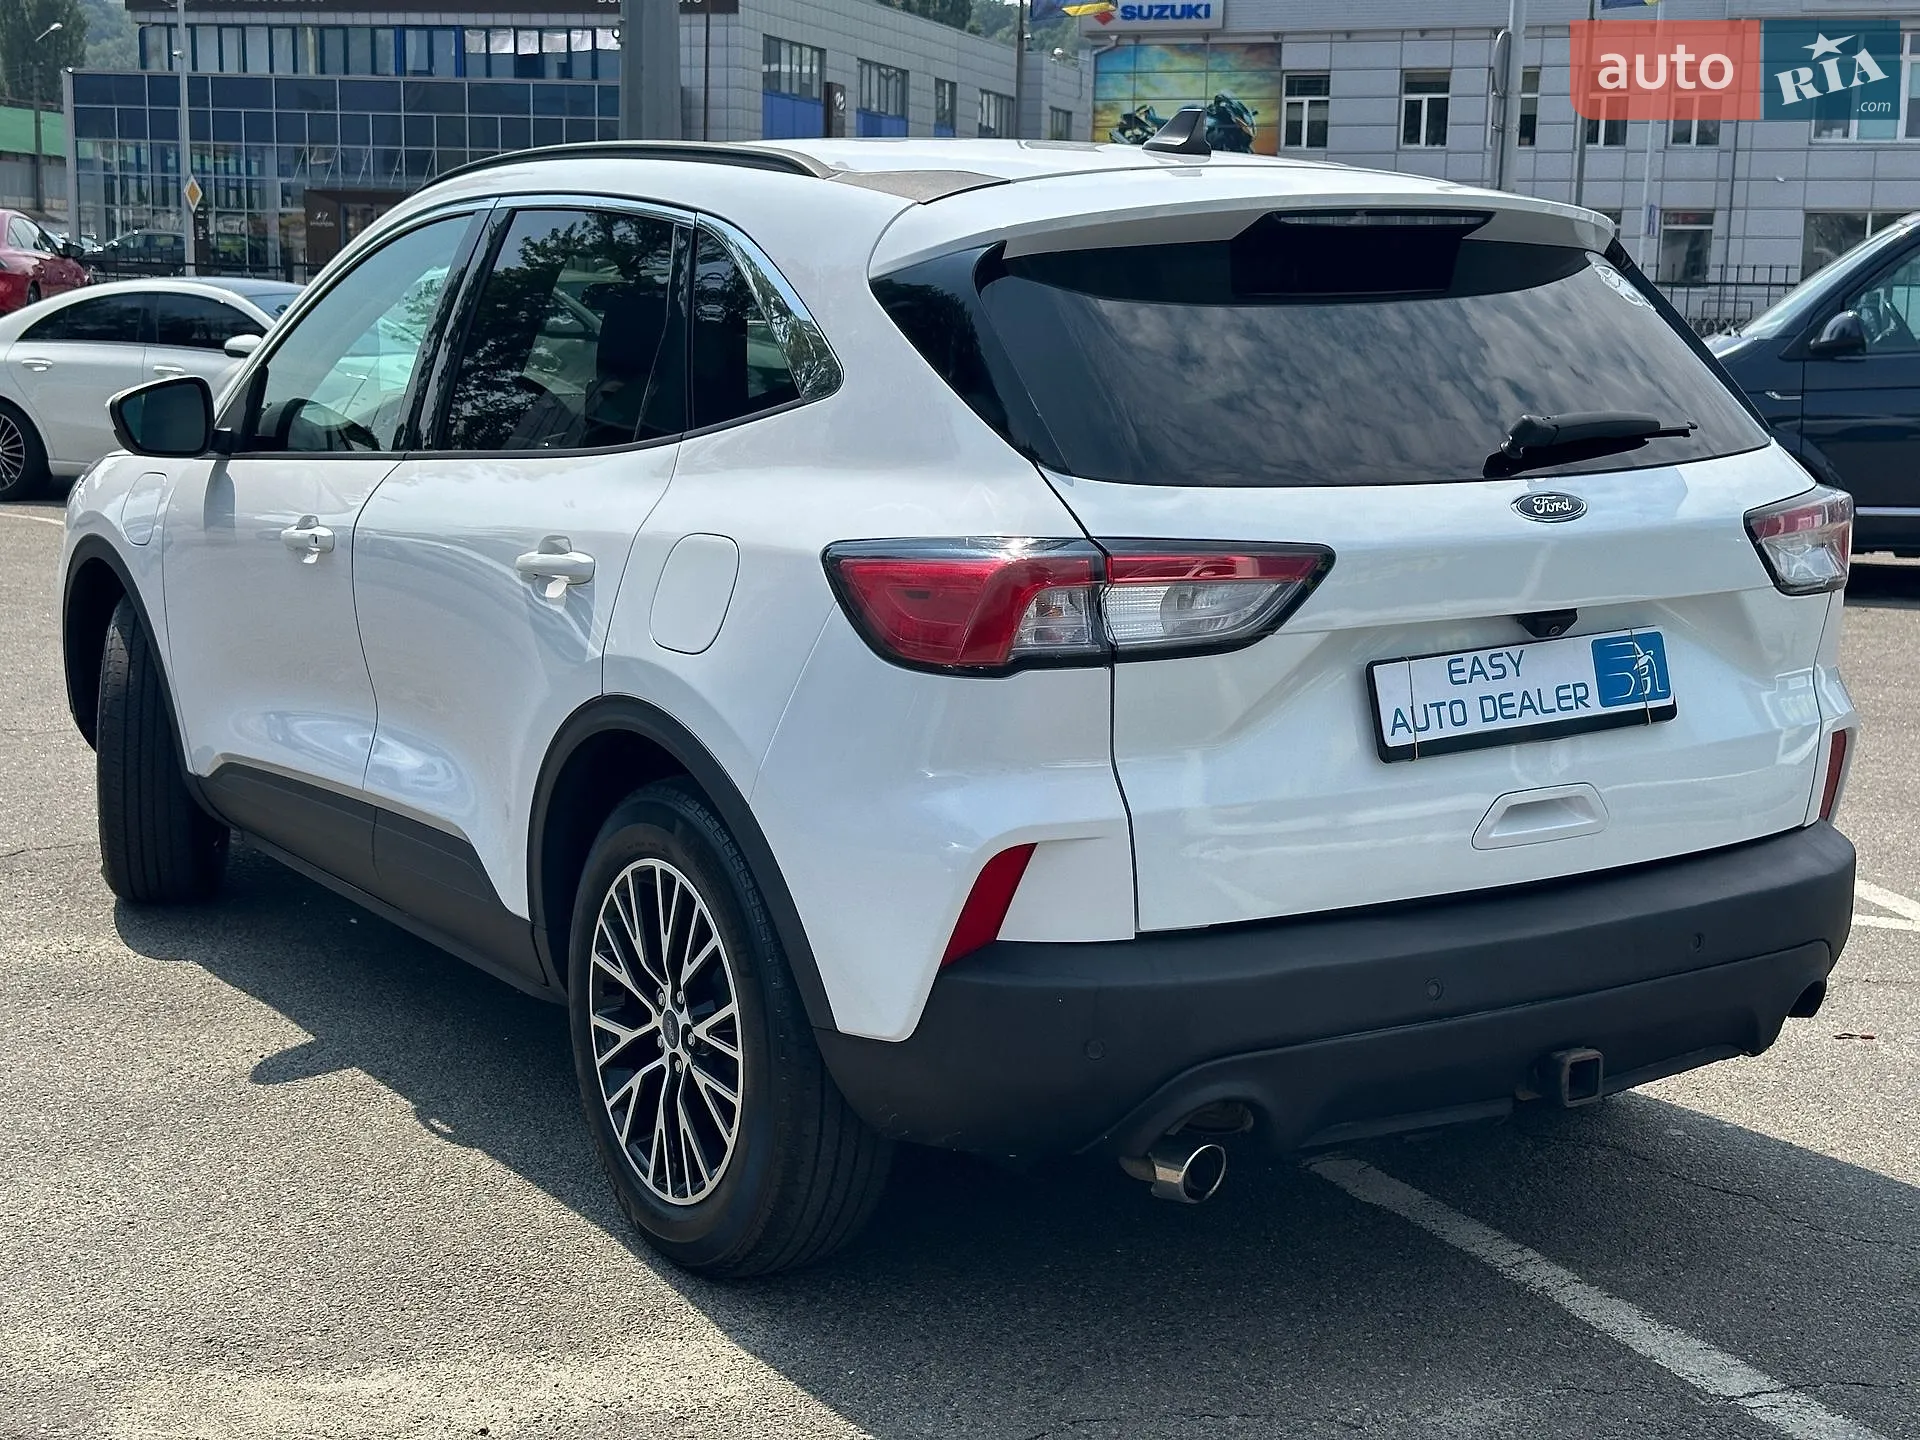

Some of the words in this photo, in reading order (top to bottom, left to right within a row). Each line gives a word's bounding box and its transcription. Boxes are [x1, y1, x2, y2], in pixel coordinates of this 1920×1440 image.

[1120, 4, 1211, 20] SUZUKI
[1532, 495, 1573, 514] Ford
[1447, 649, 1525, 686] EASY
[1390, 699, 1468, 737] AUTO
[1479, 682, 1591, 723] DEALER
